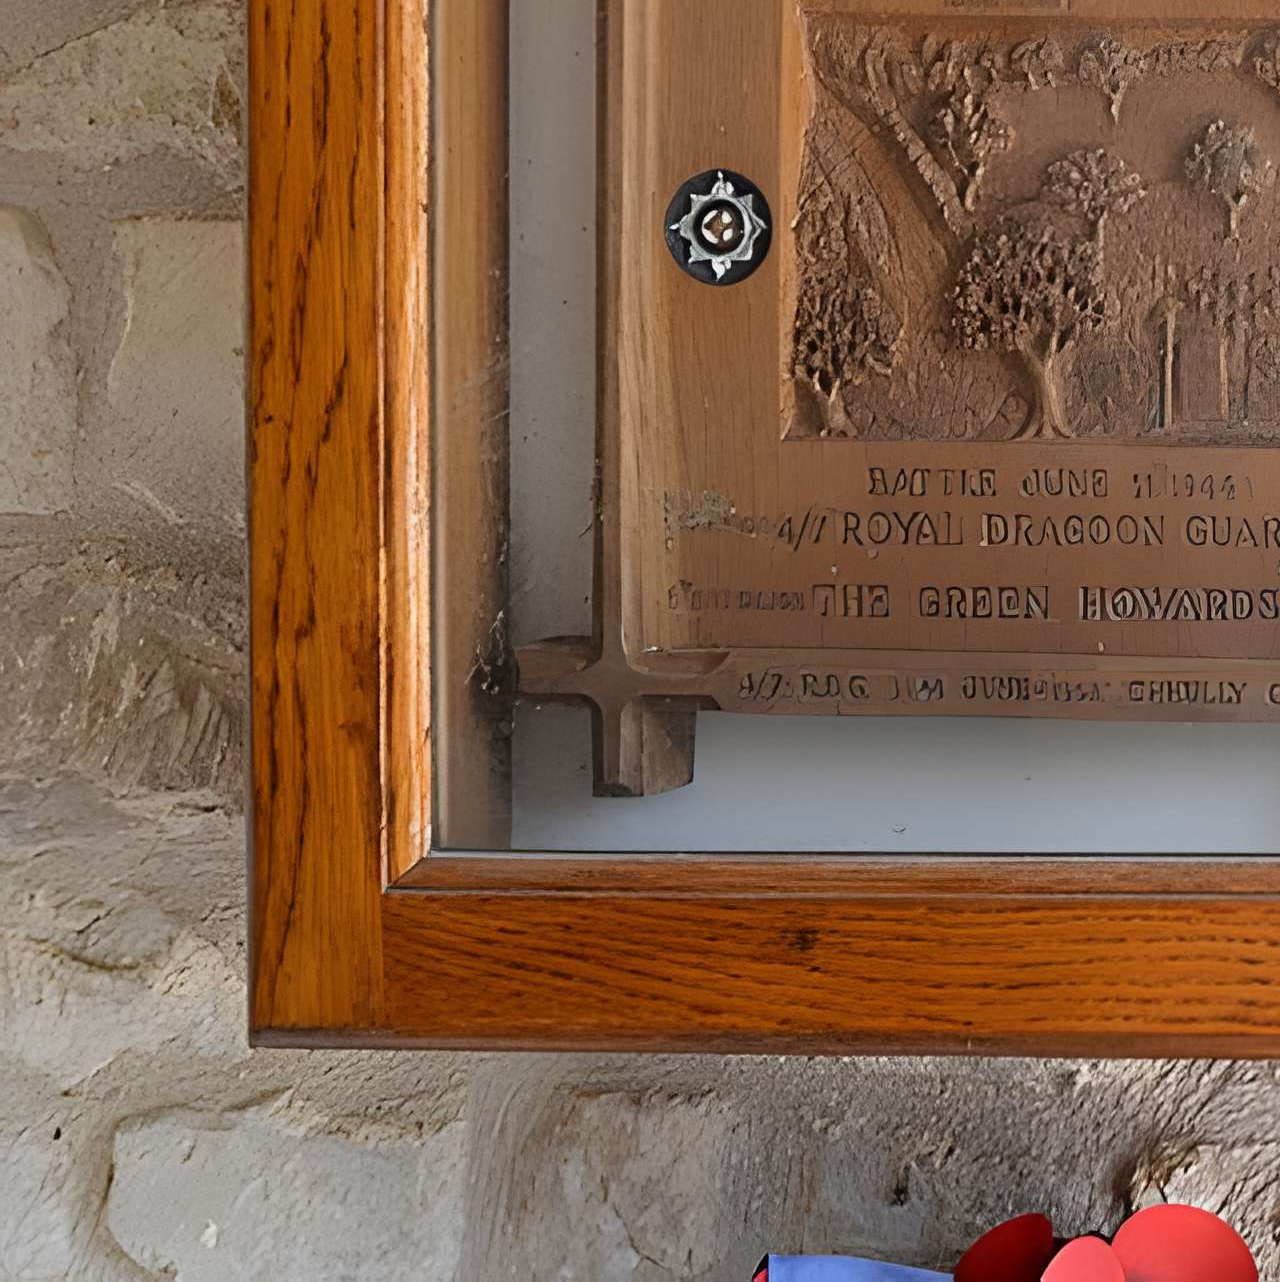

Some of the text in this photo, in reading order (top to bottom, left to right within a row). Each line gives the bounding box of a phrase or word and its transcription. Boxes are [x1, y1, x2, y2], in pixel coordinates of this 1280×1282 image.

[868, 468, 997, 496] BATTLE
[1021, 469, 1108, 497] JUNE
[842, 512, 964, 546] ROYAL
[979, 514, 1164, 547] DRAGOON
[812, 584, 890, 618] THE
[919, 585, 1050, 619] GREEN
[1079, 585, 1280, 621] HOWARDS
